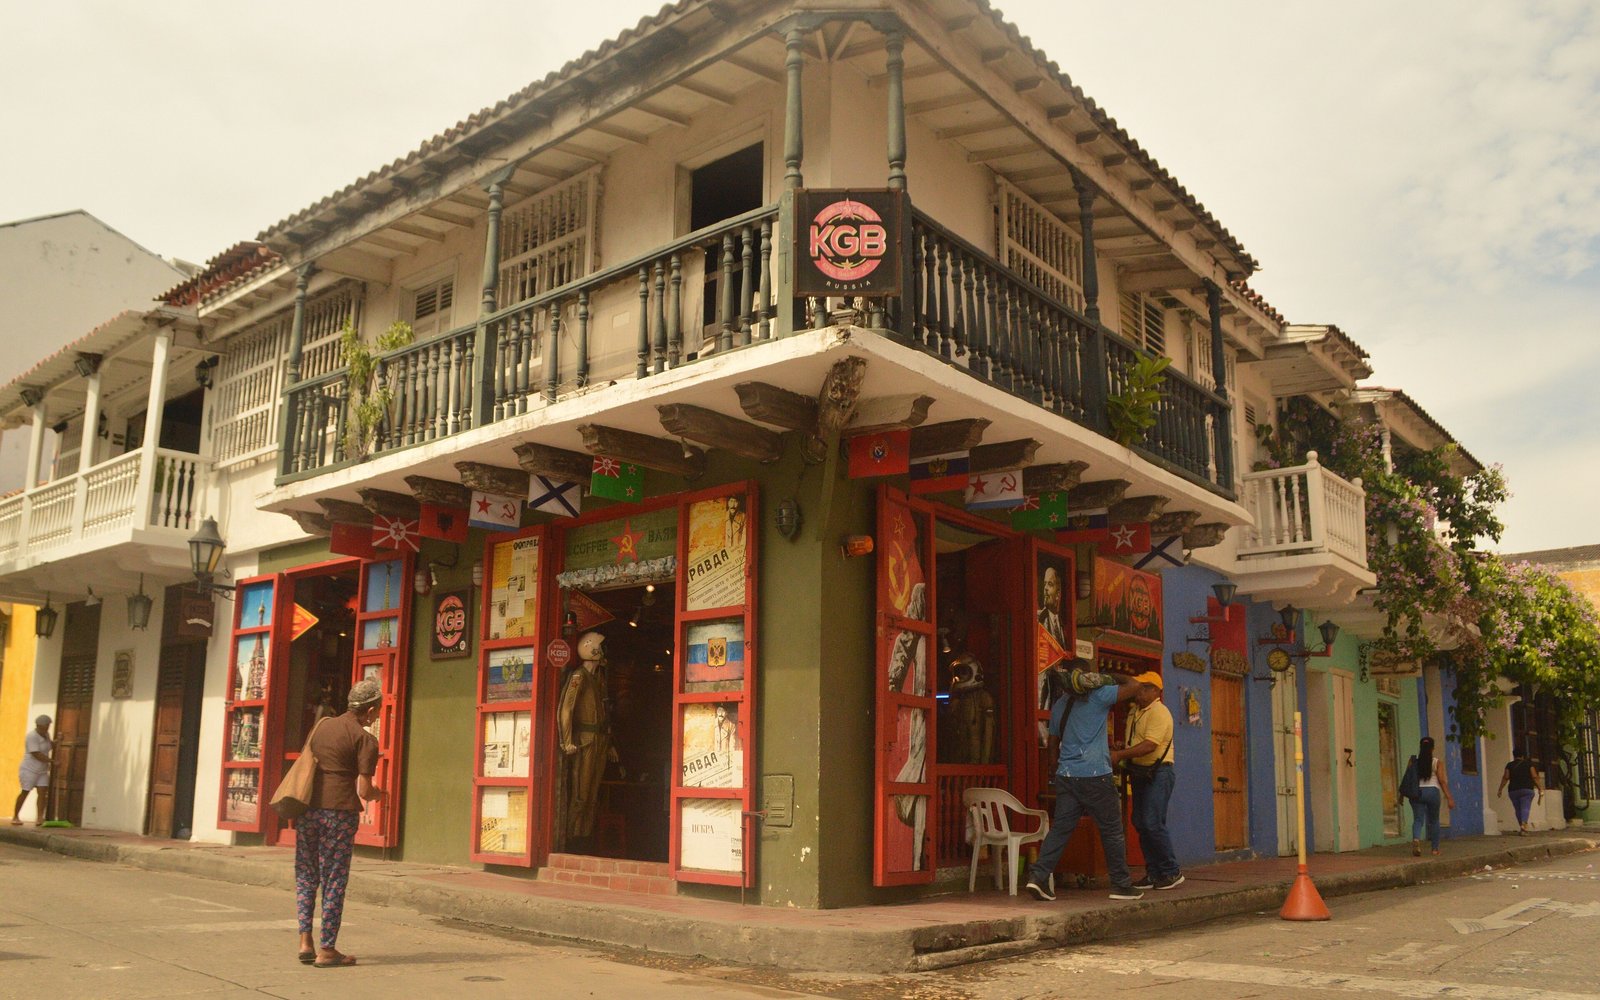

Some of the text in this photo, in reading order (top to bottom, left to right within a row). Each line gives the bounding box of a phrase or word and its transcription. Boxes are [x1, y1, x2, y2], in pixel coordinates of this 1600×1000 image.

[810, 224, 887, 257] KGB
[826, 280, 871, 290] RUSSIA
[573, 538, 609, 555] COFFEE
[687, 549, 729, 583] РАВДА
[436, 610, 465, 633] KGB
[550, 649, 568, 657] KGB
[691, 824, 715, 834] ИСКРА
